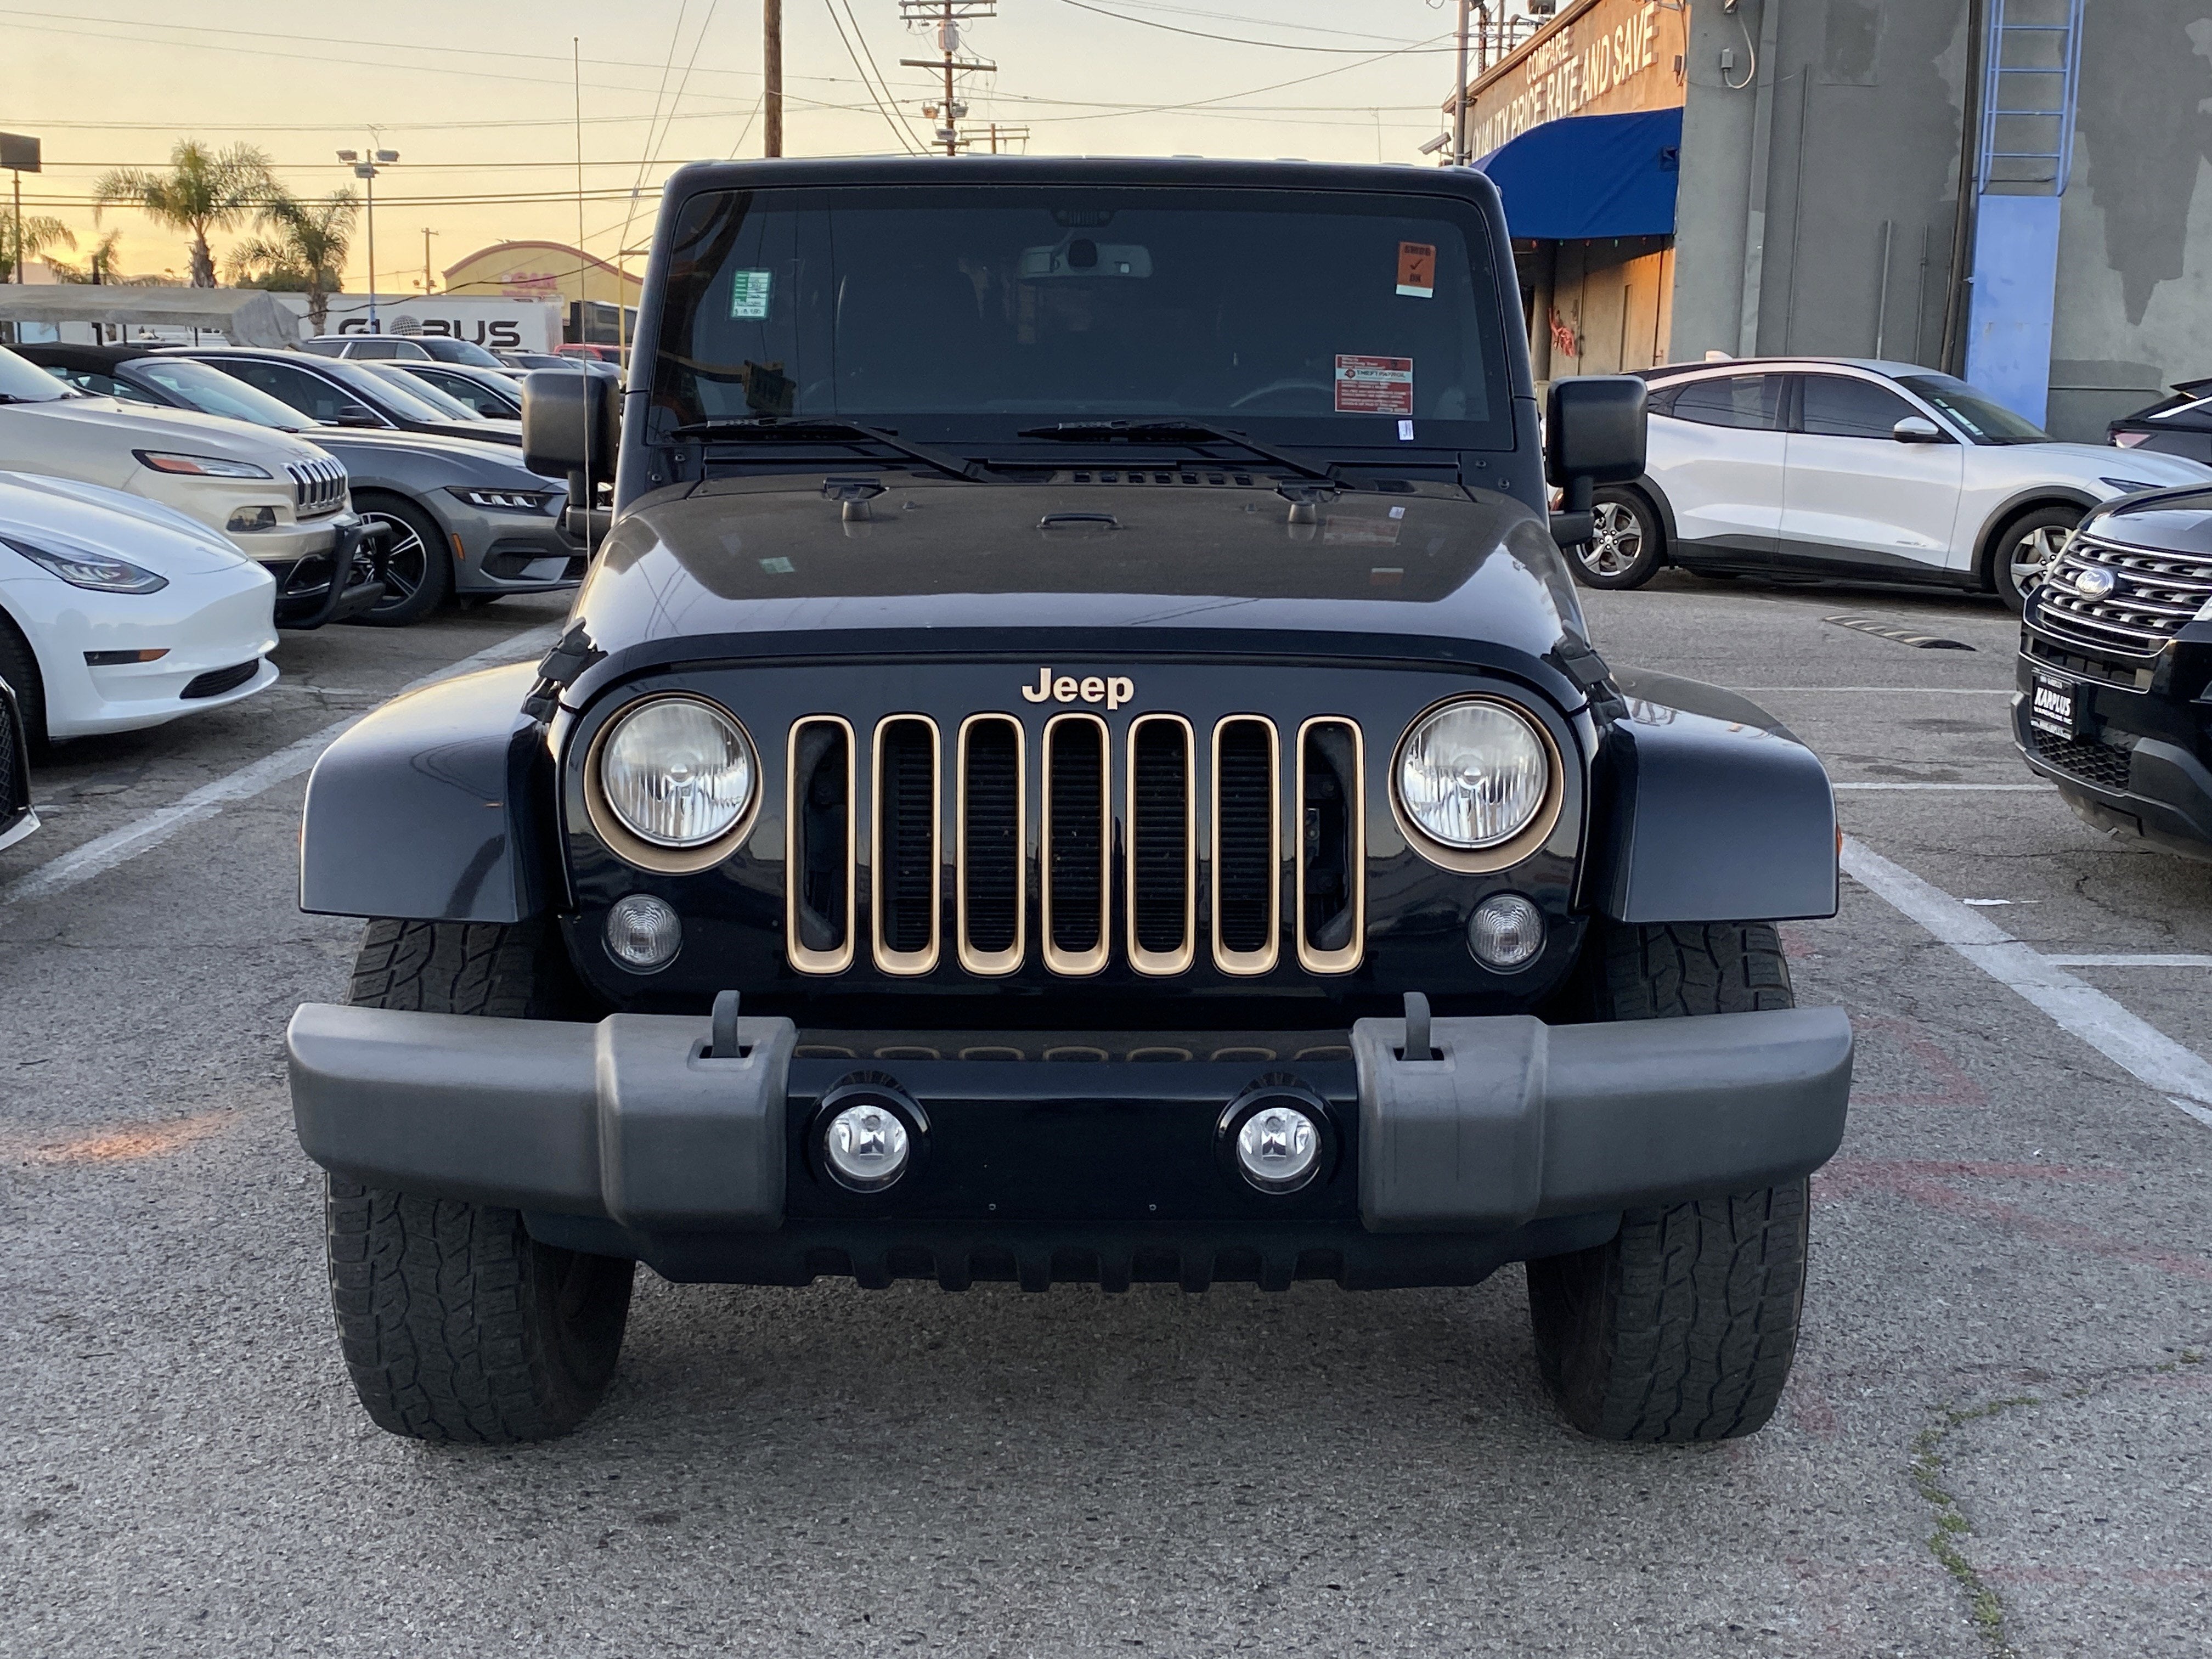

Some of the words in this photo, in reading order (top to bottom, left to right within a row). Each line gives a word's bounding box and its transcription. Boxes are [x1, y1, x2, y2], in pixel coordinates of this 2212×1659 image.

[1511, 81, 1544, 140] PRICE
[1547, 55, 1579, 121] RATE
[1579, 34, 1610, 106] AND
[1612, 2, 1655, 86] SAVE
[1527, 26, 1570, 85] COMPARE
[1022, 667, 1135, 710] Jeep
[2034, 686, 2072, 717] KARPLUS
